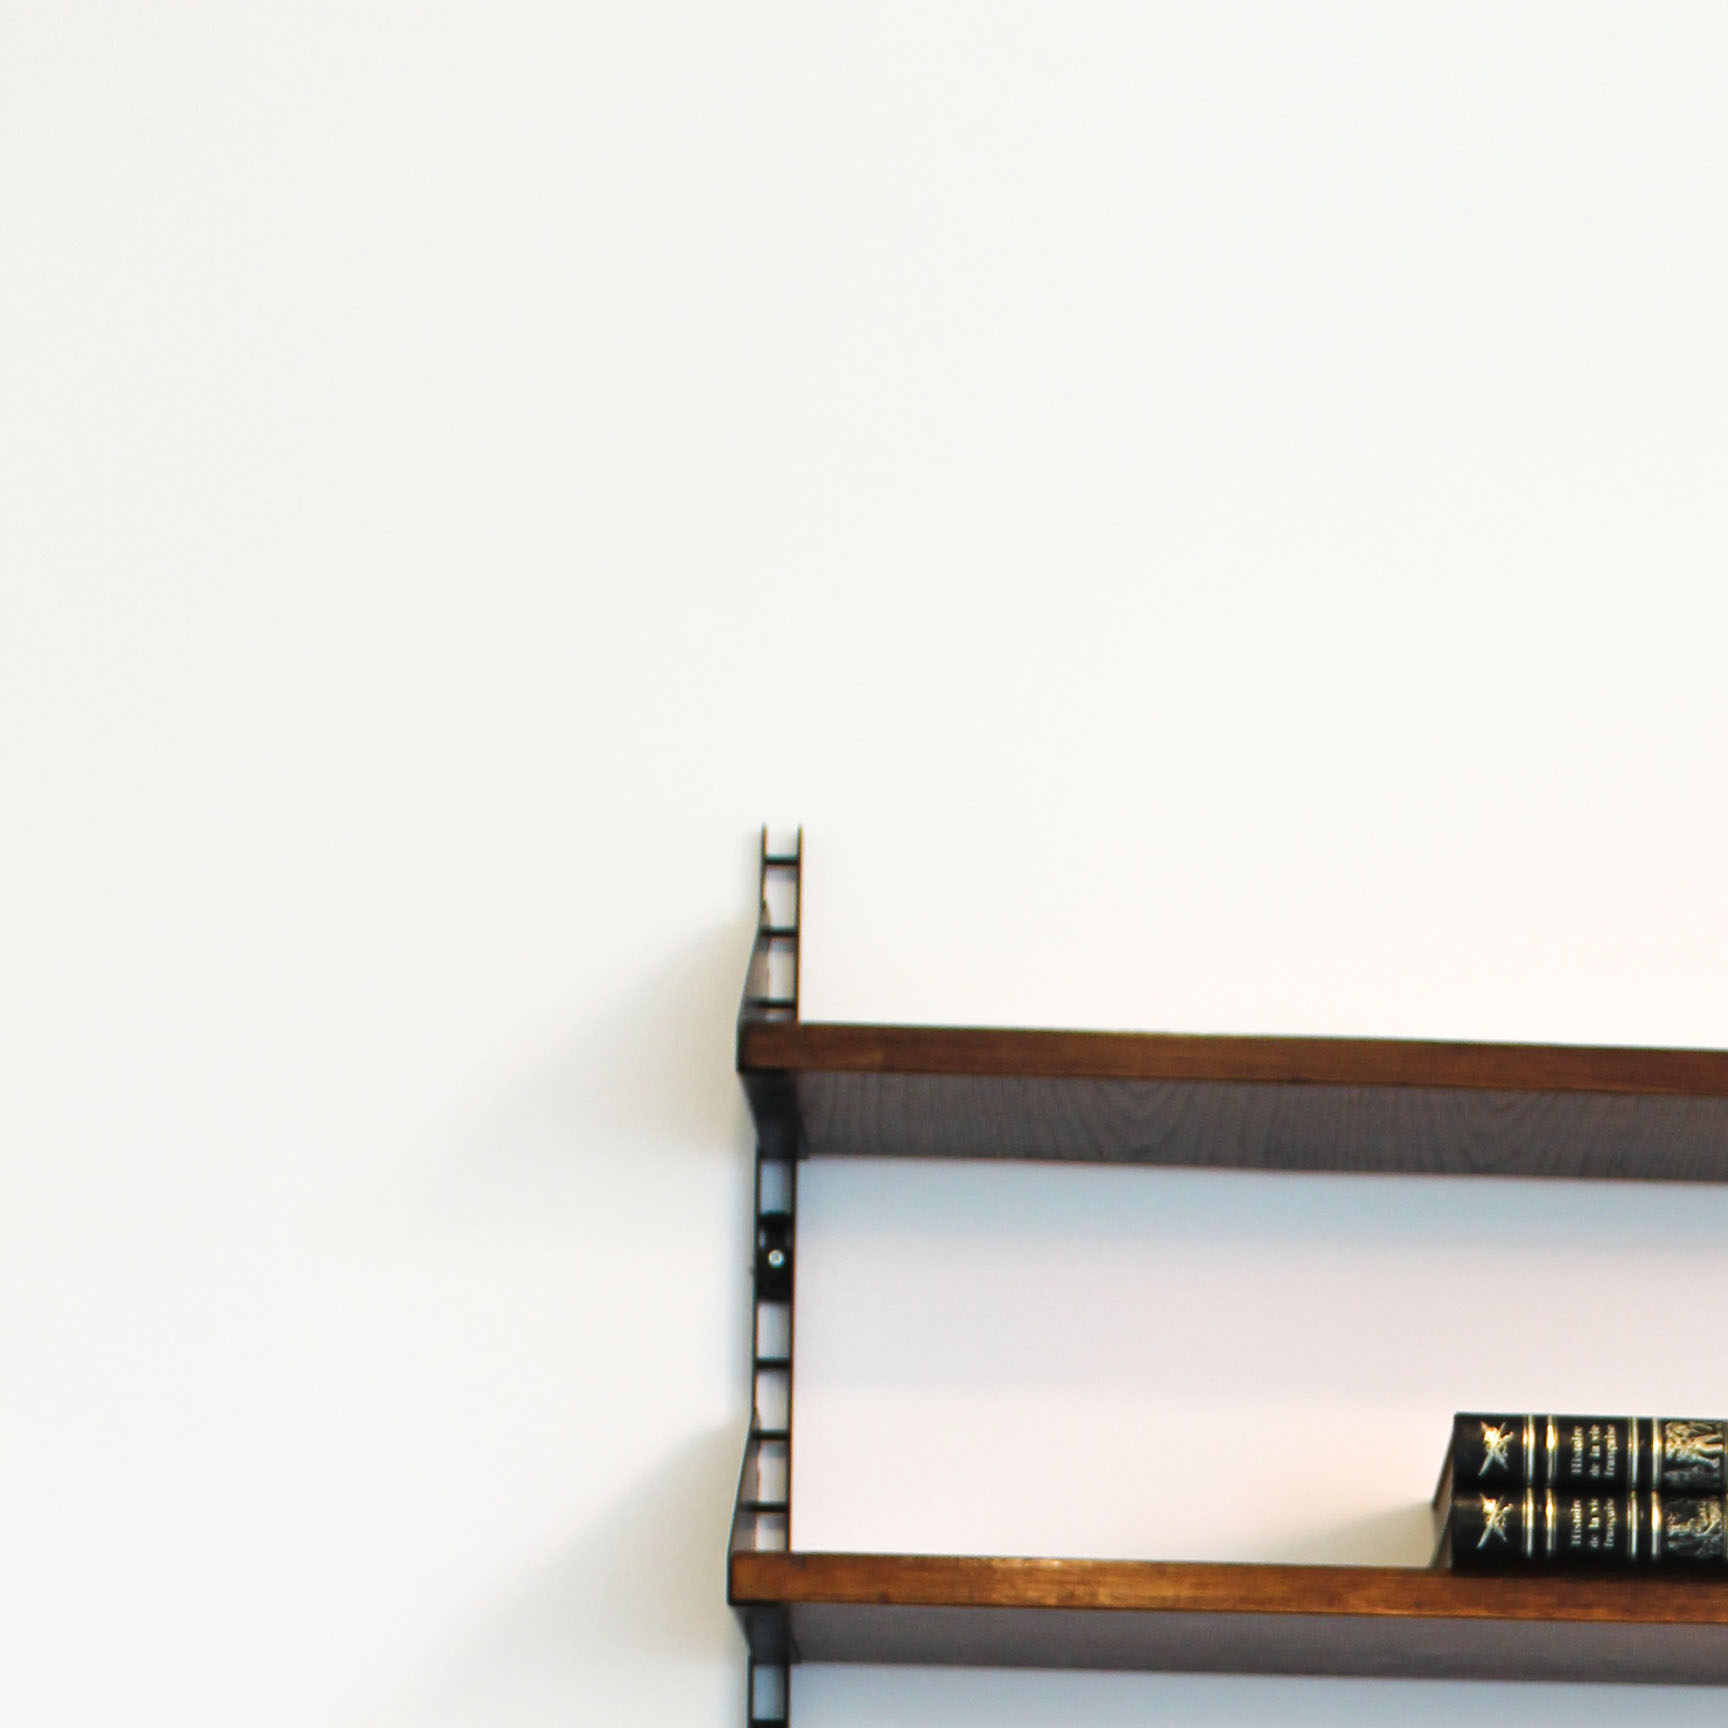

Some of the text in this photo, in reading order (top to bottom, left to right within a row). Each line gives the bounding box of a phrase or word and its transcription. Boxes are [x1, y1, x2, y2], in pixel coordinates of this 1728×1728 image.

[1570, 1425, 1583, 1475] Histoire
[1588, 1424, 1601, 1477] de la vie
[1603, 1423, 1618, 1477] française
[1570, 1498, 1582, 1546] Histoire
[1588, 1497, 1600, 1548] de la vie
